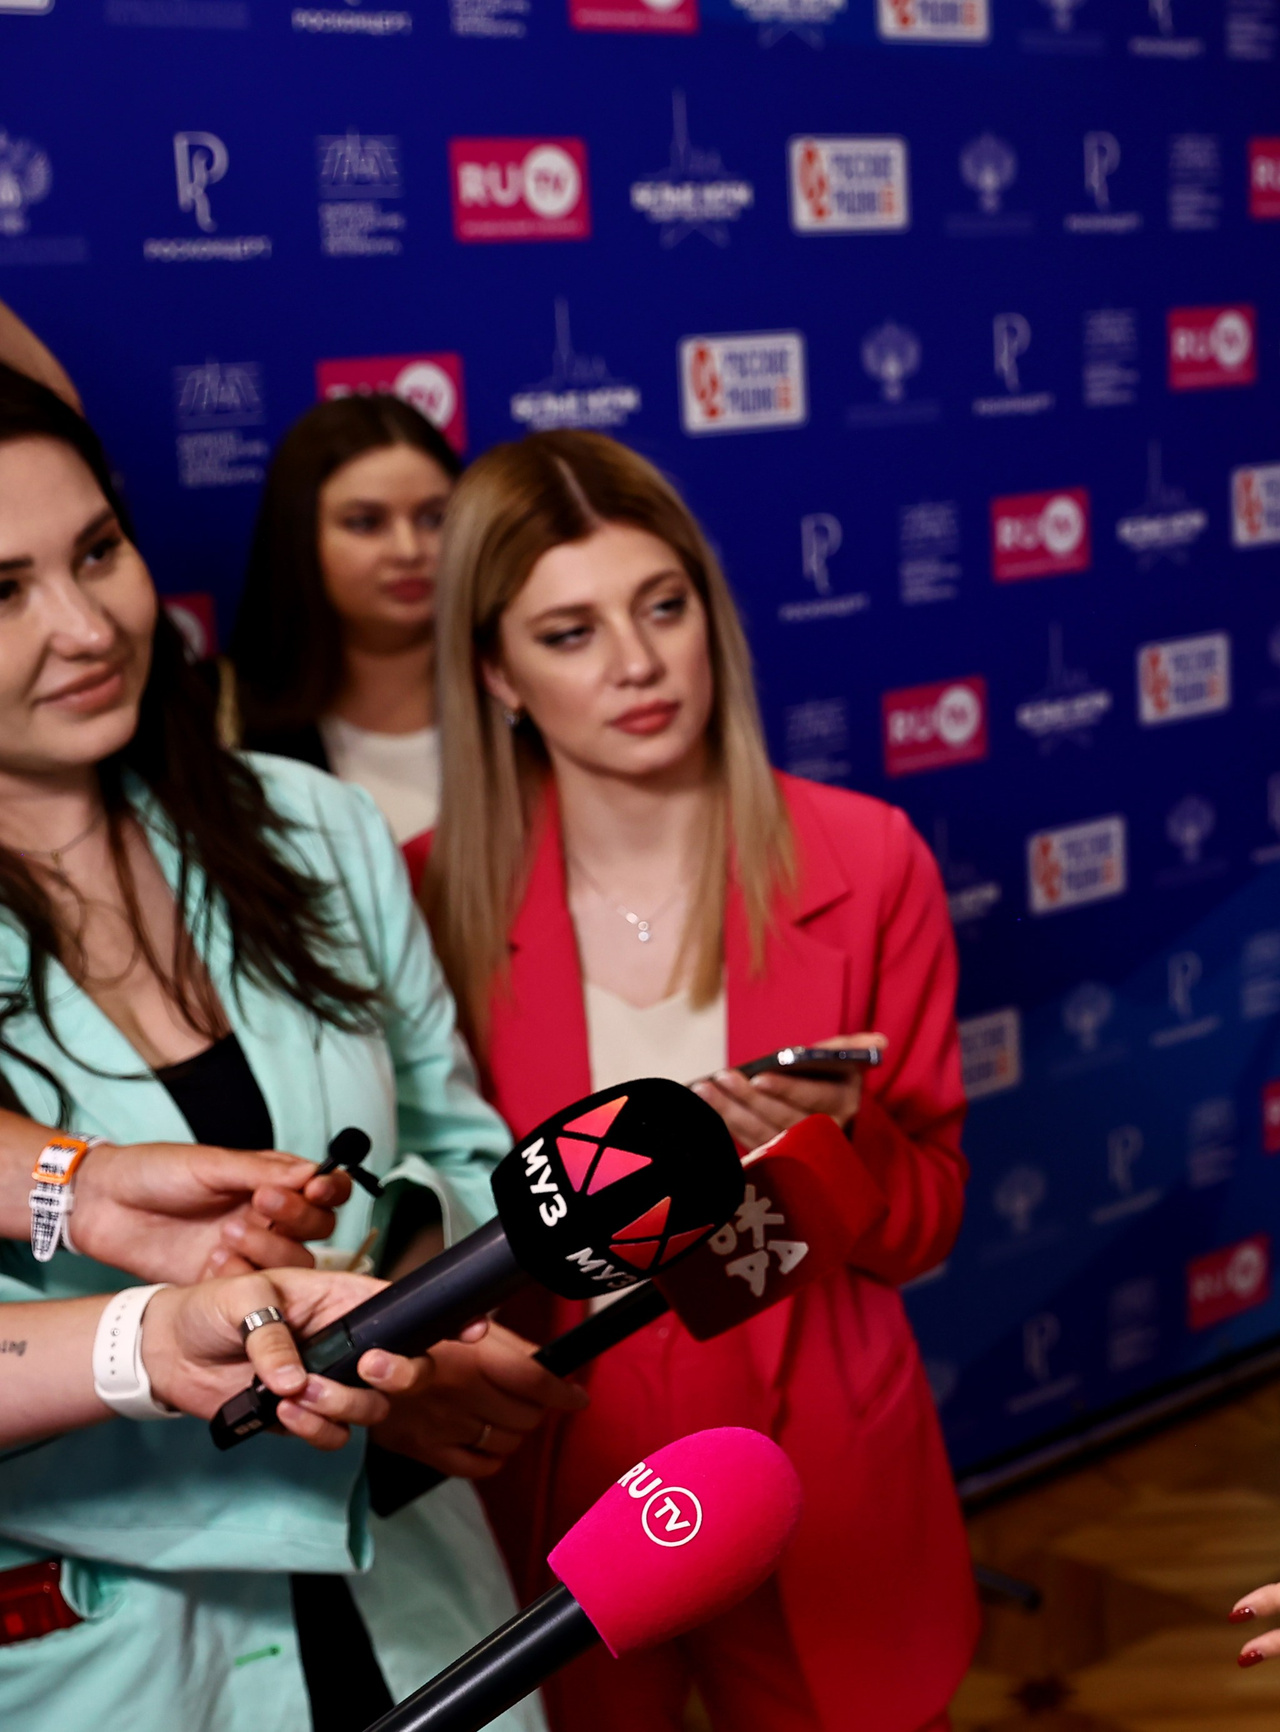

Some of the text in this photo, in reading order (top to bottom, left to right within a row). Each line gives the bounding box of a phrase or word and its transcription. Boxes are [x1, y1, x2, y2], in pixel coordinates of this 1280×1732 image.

[521, 1137, 568, 1227] МУЗ
[565, 1246, 638, 1290] МУЗ
[617, 1461, 691, 1532] RU TV
